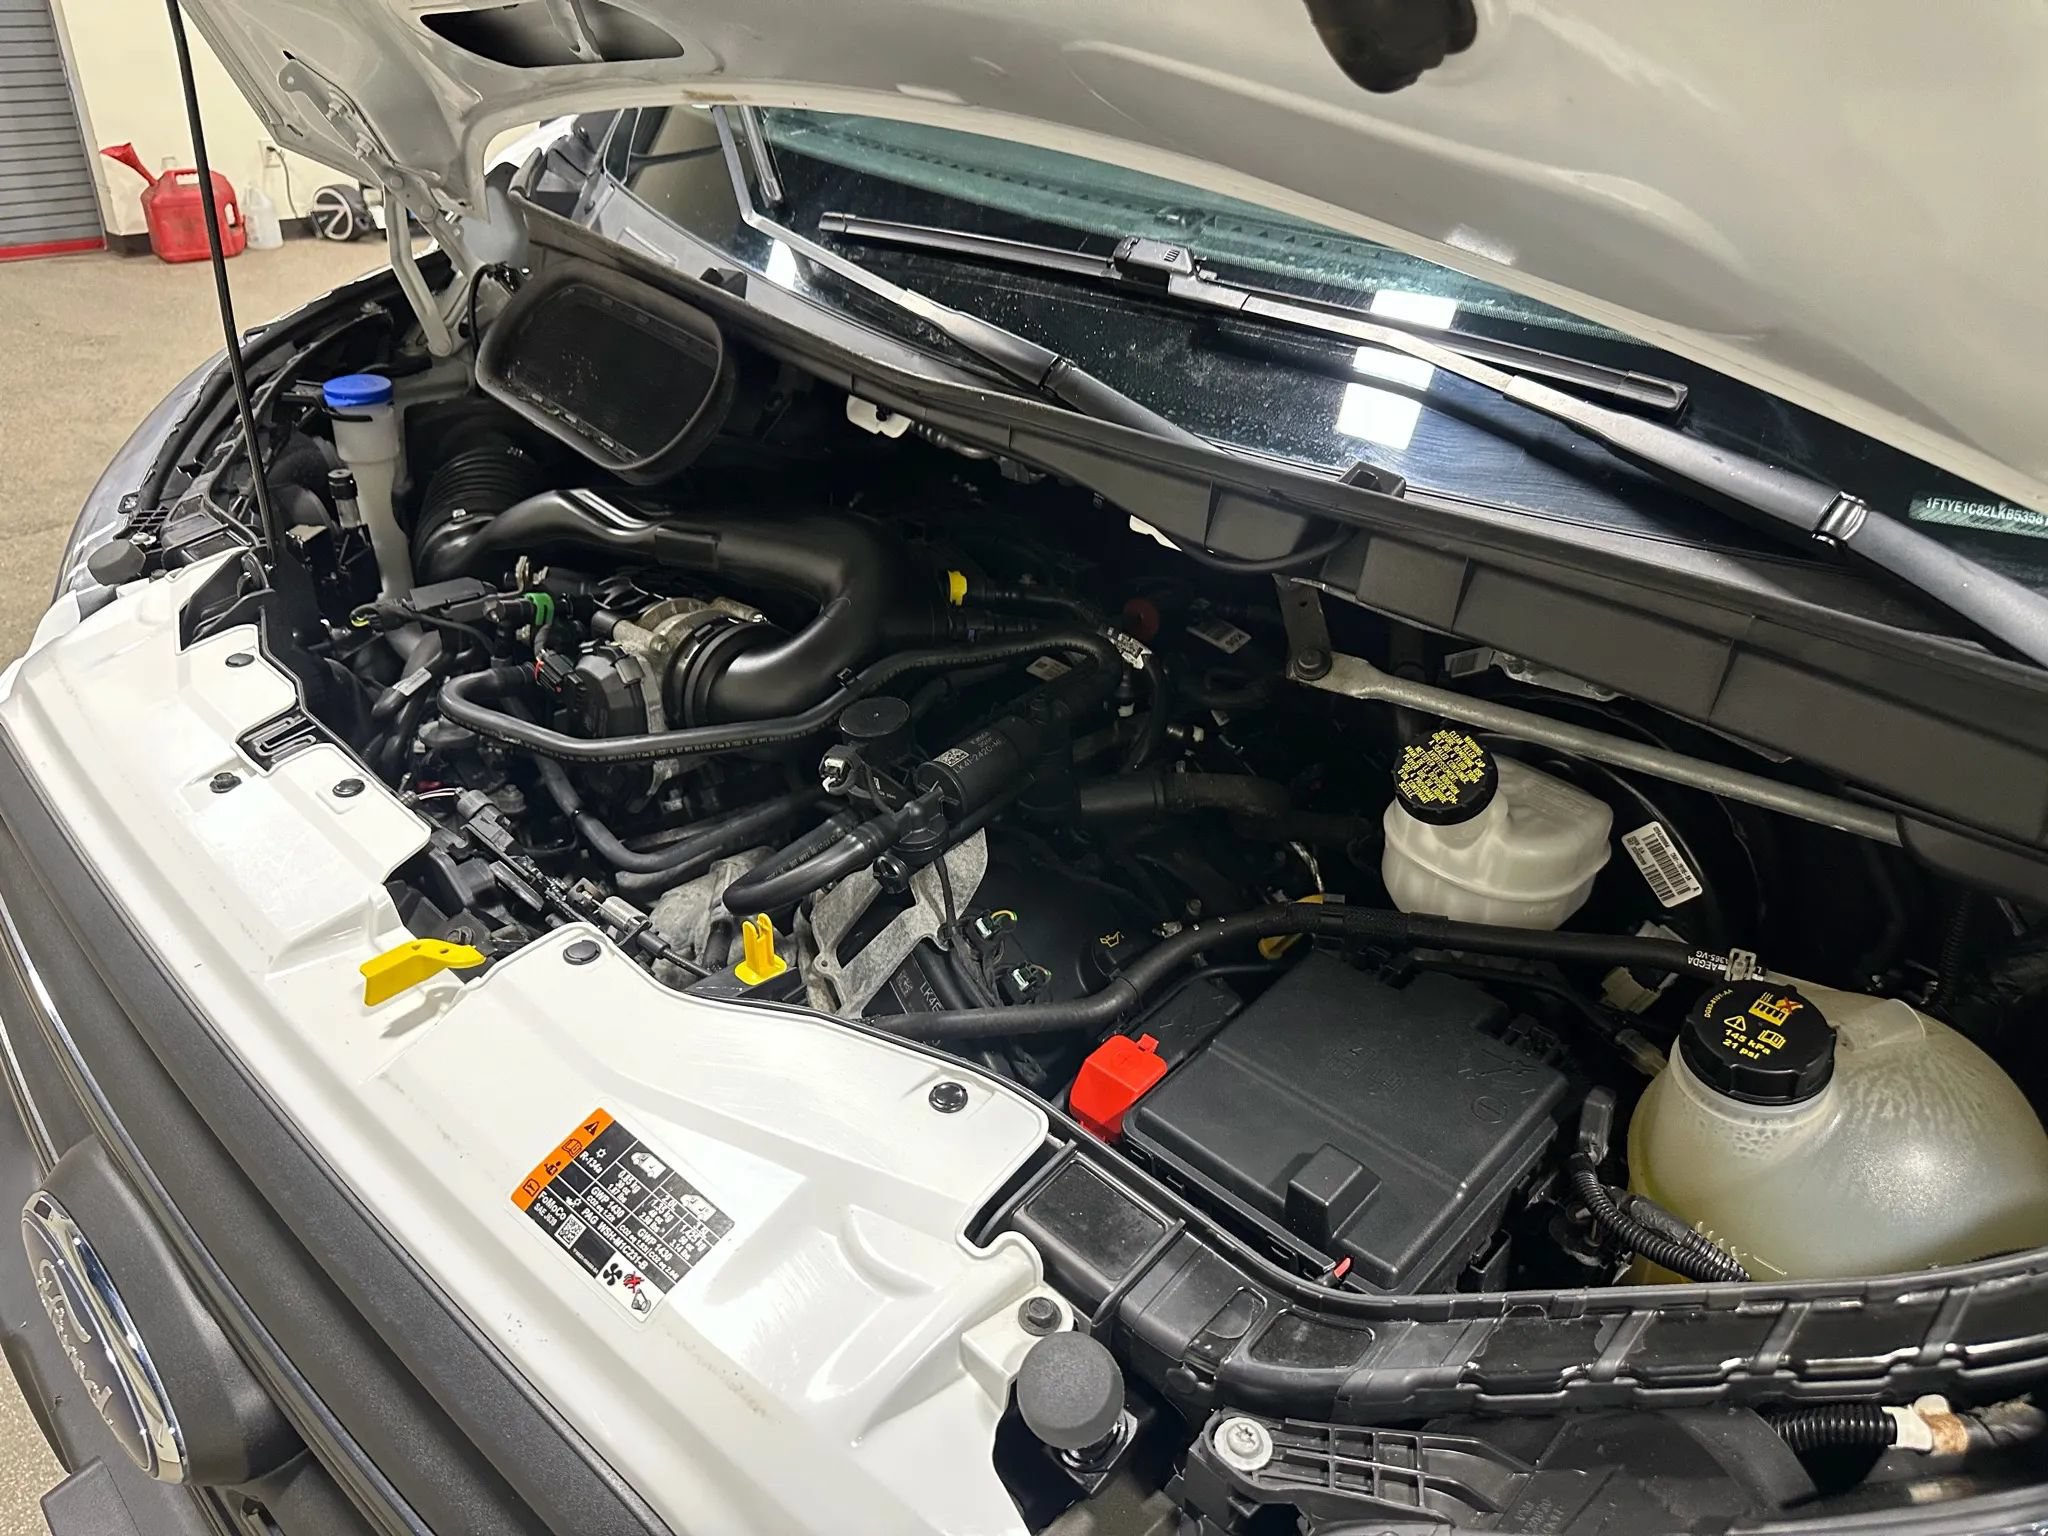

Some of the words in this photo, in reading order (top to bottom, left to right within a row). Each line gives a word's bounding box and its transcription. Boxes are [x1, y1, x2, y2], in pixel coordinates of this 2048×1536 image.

[1926, 497, 2048, 527] 1FTYE1C82LKB5358
[1474, 758, 1486, 768] CAP
[1688, 956, 1718, 971] AEGDA
[1722, 1038, 1739, 1049] 21
[1739, 1048, 1760, 1059] psi
[1726, 1029, 1747, 1042] 145
[1748, 1039, 1771, 1055] kPa
[579, 1151, 603, 1174] R-134a
[618, 1170, 635, 1185] 0.85
[629, 1181, 641, 1194] kg
[534, 1203, 547, 1216] SAE
[538, 1190, 567, 1220] FoMoCo
[591, 1186, 610, 1203] GWP
[607, 1201, 625, 1218] 1430
[651, 1199, 667, 1214] 1.35
[661, 1210, 675, 1223] kg
[581, 1208, 599, 1225] PAG
[597, 1221, 649, 1270] WSH-M1C231-B
[637, 1228, 657, 1245] GWP
[654, 1243, 673, 1261] 1430
[693, 1239, 707, 1252] kg
